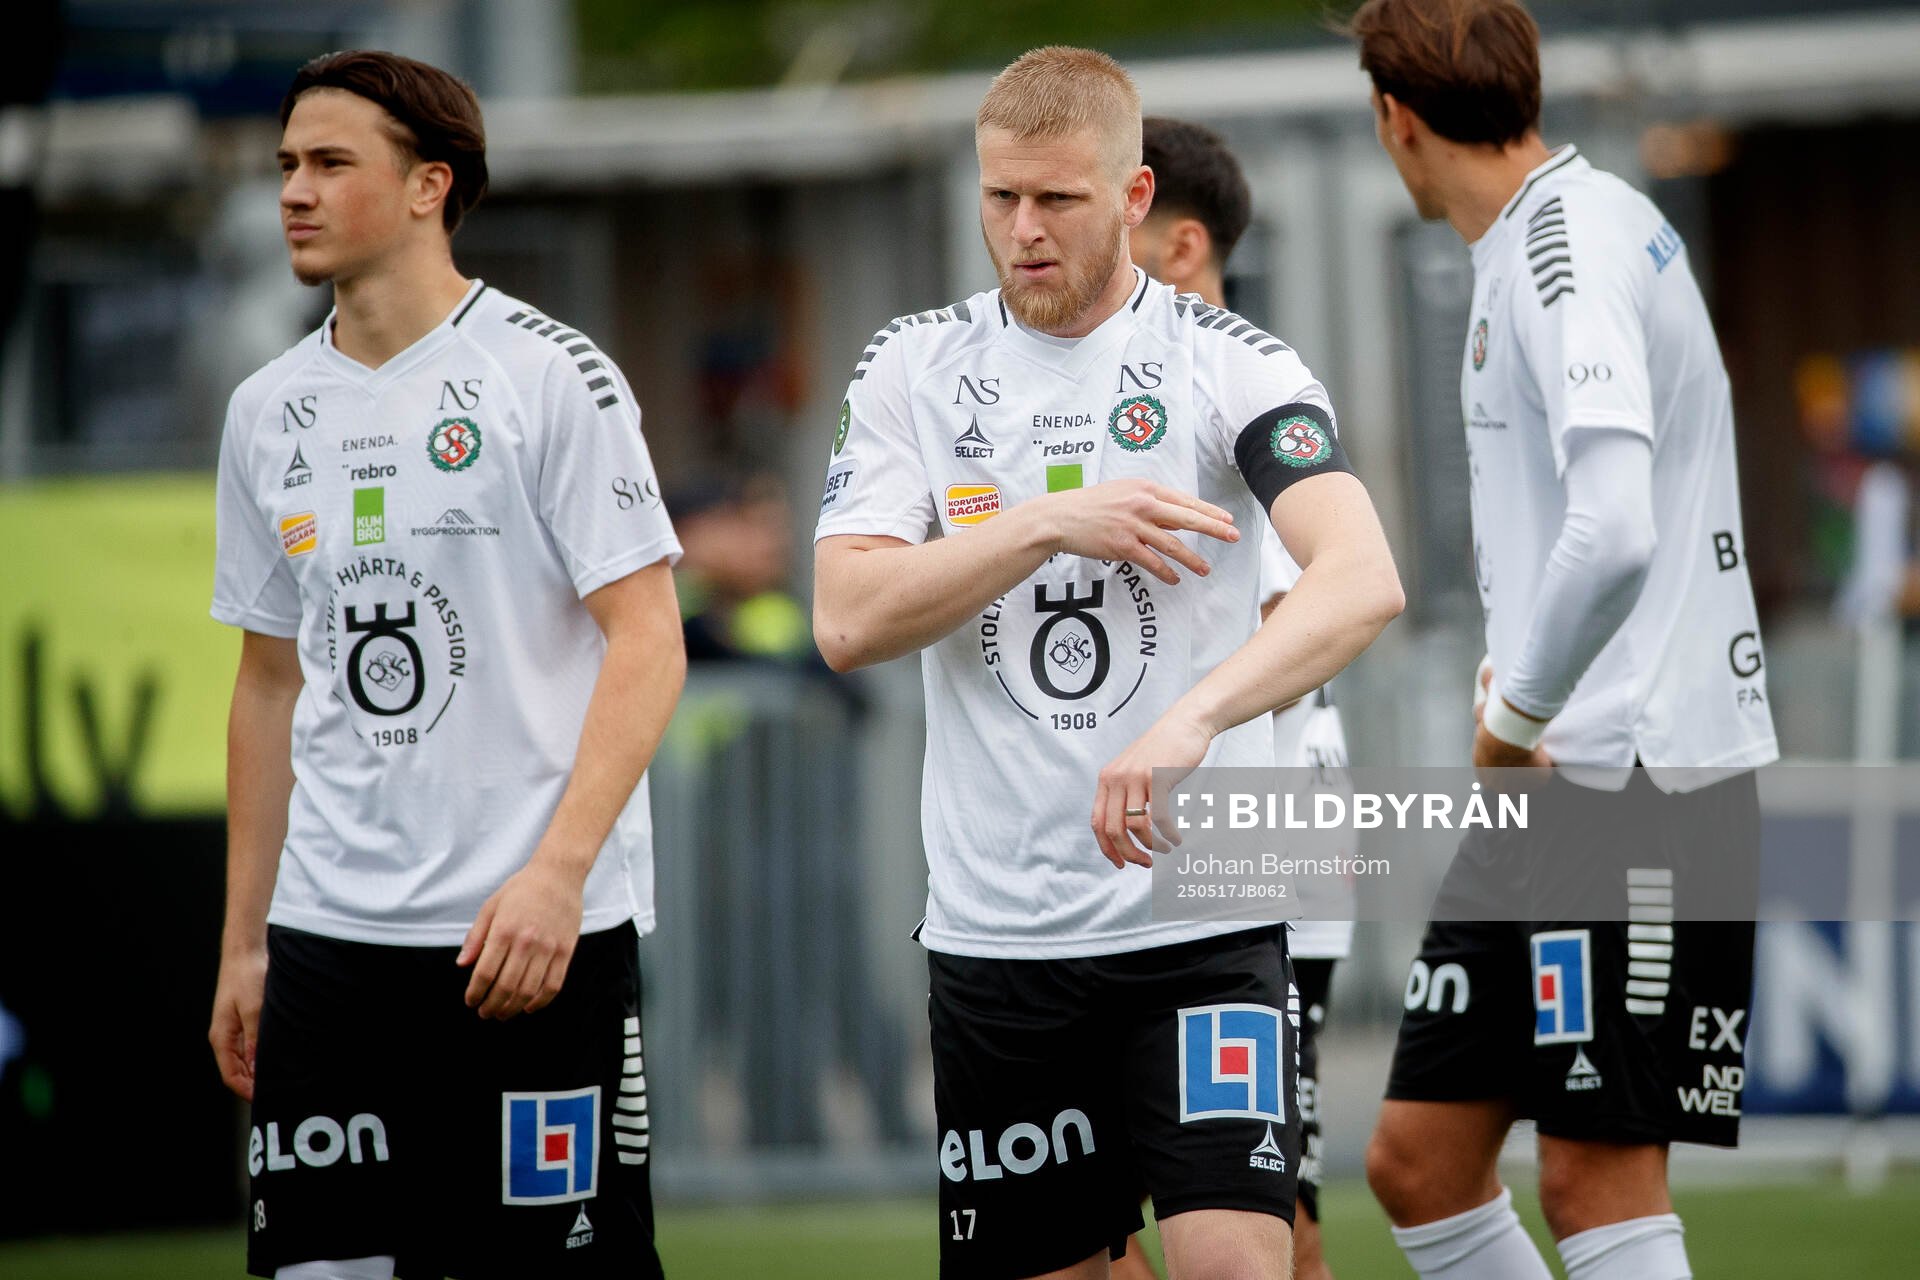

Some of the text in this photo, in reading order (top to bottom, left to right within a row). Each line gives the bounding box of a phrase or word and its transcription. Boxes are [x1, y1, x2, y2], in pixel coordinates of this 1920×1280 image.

[1033, 413, 1096, 428] ENENDA.
[342, 435, 399, 452] ENENDA.
[954, 446, 995, 459] SELECT
[283, 472, 313, 489] SELECT
[825, 470, 854, 494] BET
[948, 501, 1000, 517] BAGARN
[356, 515, 383, 529] KUM
[356, 528, 383, 542] BRO
[411, 527, 500, 536] BYGGPRODUKTION
[336, 556, 407, 586] HJÄRTA
[424, 584, 466, 677] PASSION
[1115, 561, 1158, 657] PASSION
[1050, 712, 1097, 730] 1908
[372, 728, 419, 746] 1908
[1565, 1076, 1602, 1091] SELECT
[1249, 1155, 1286, 1174] SELECT
[950, 1209, 976, 1241] 17
[566, 1232, 594, 1249] SELECT
